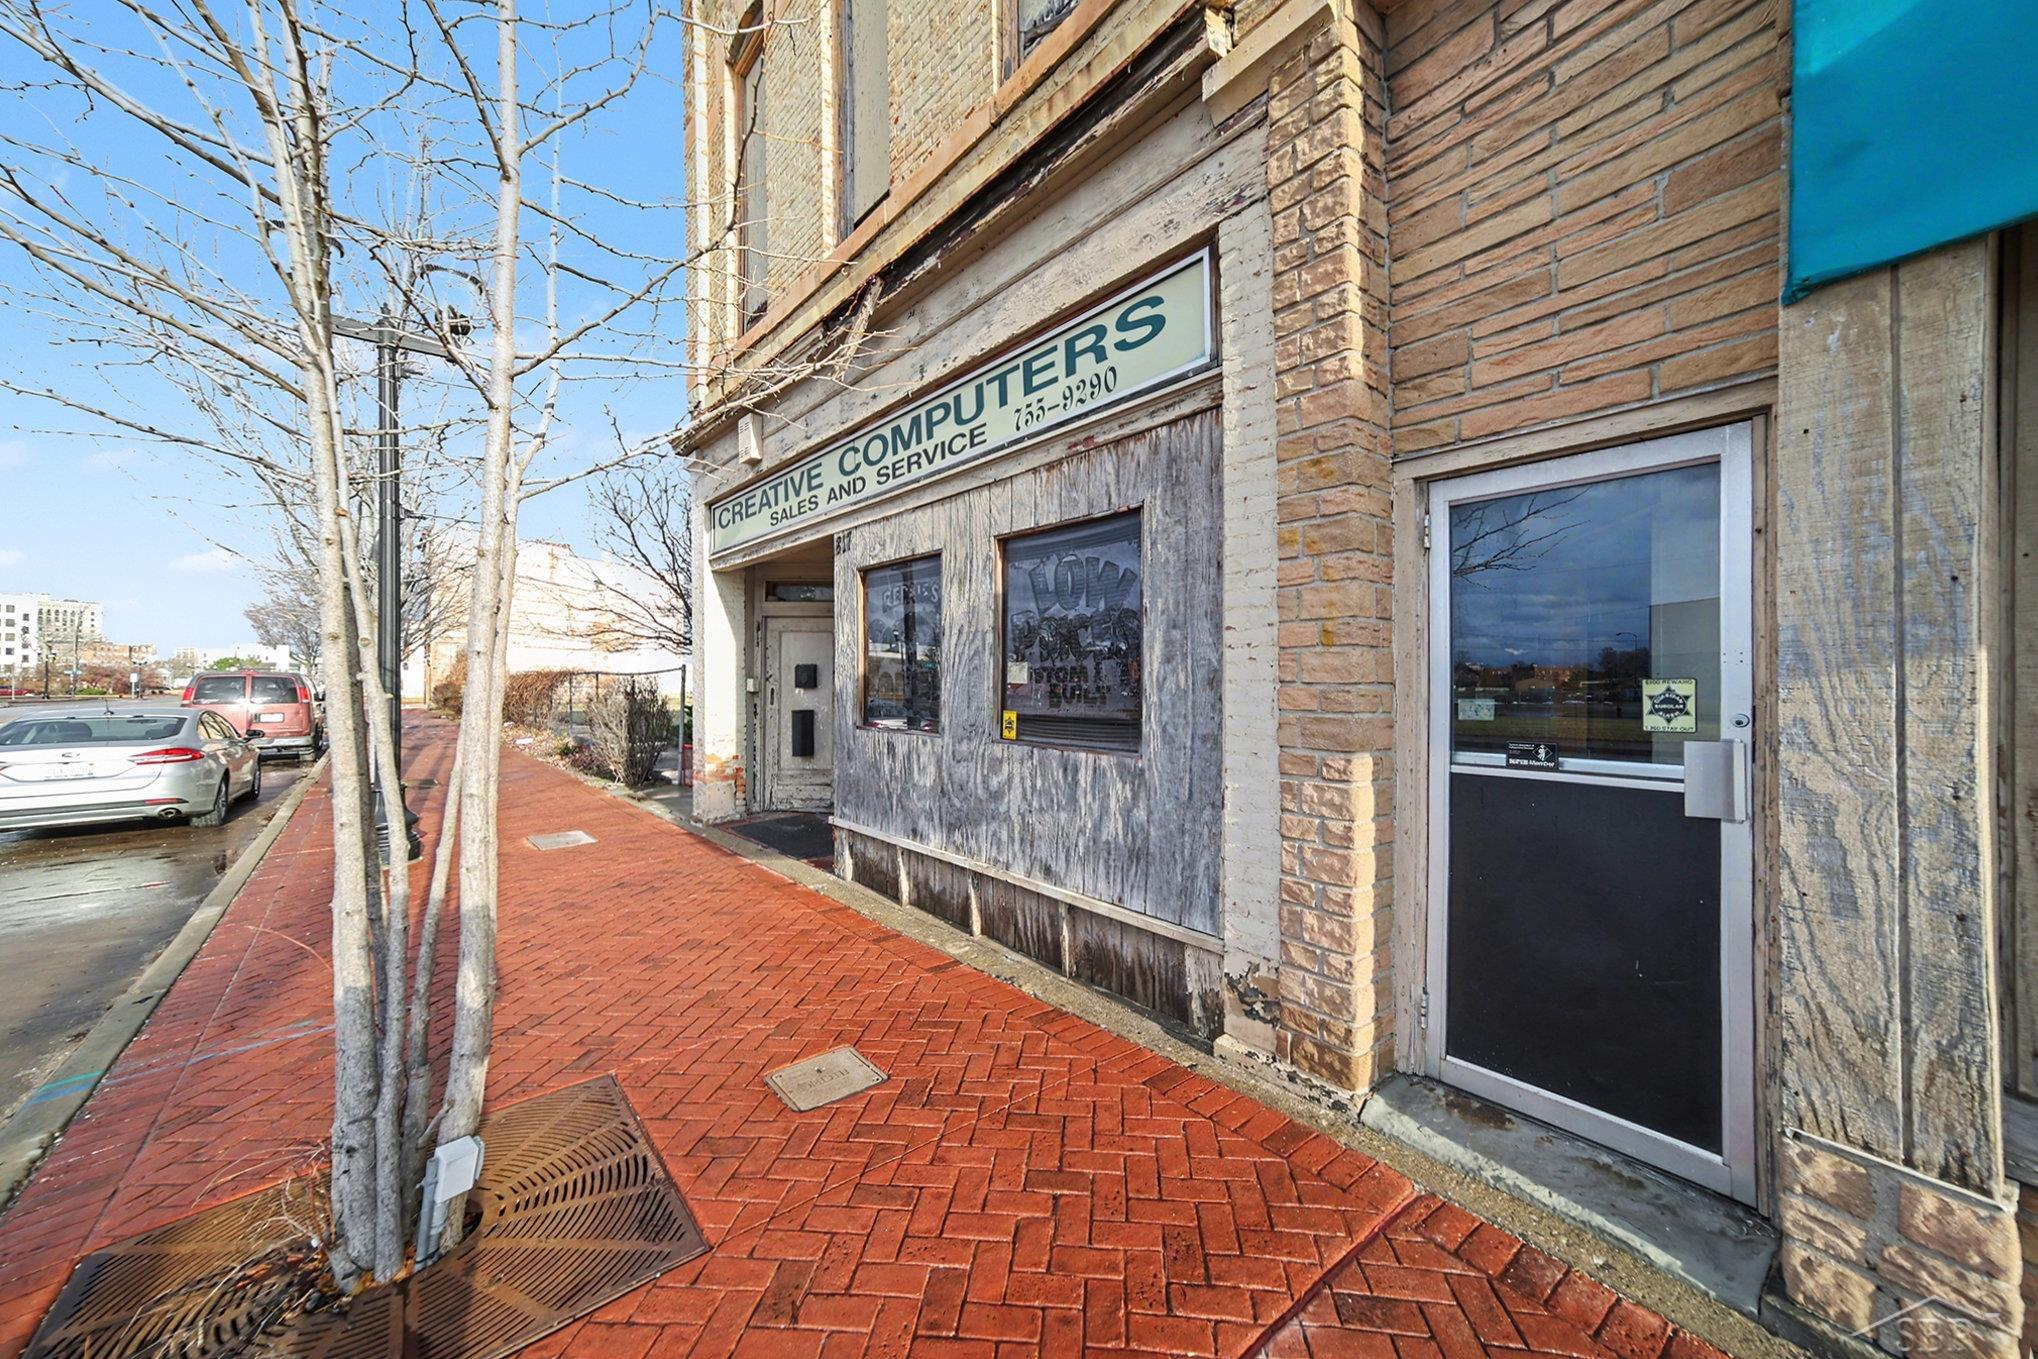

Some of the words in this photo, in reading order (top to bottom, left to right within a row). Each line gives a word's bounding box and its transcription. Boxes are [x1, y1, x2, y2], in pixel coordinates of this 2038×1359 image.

[718, 462, 824, 529] CREATIVE
[838, 295, 1167, 477] COMPUTERS
[770, 494, 819, 527] SALES
[826, 476, 866, 505] AND
[876, 422, 988, 485] SERVICE
[1014, 365, 1117, 432] 755-9290
[836, 531, 852, 555] 817
[1028, 553, 1138, 616] LOW
